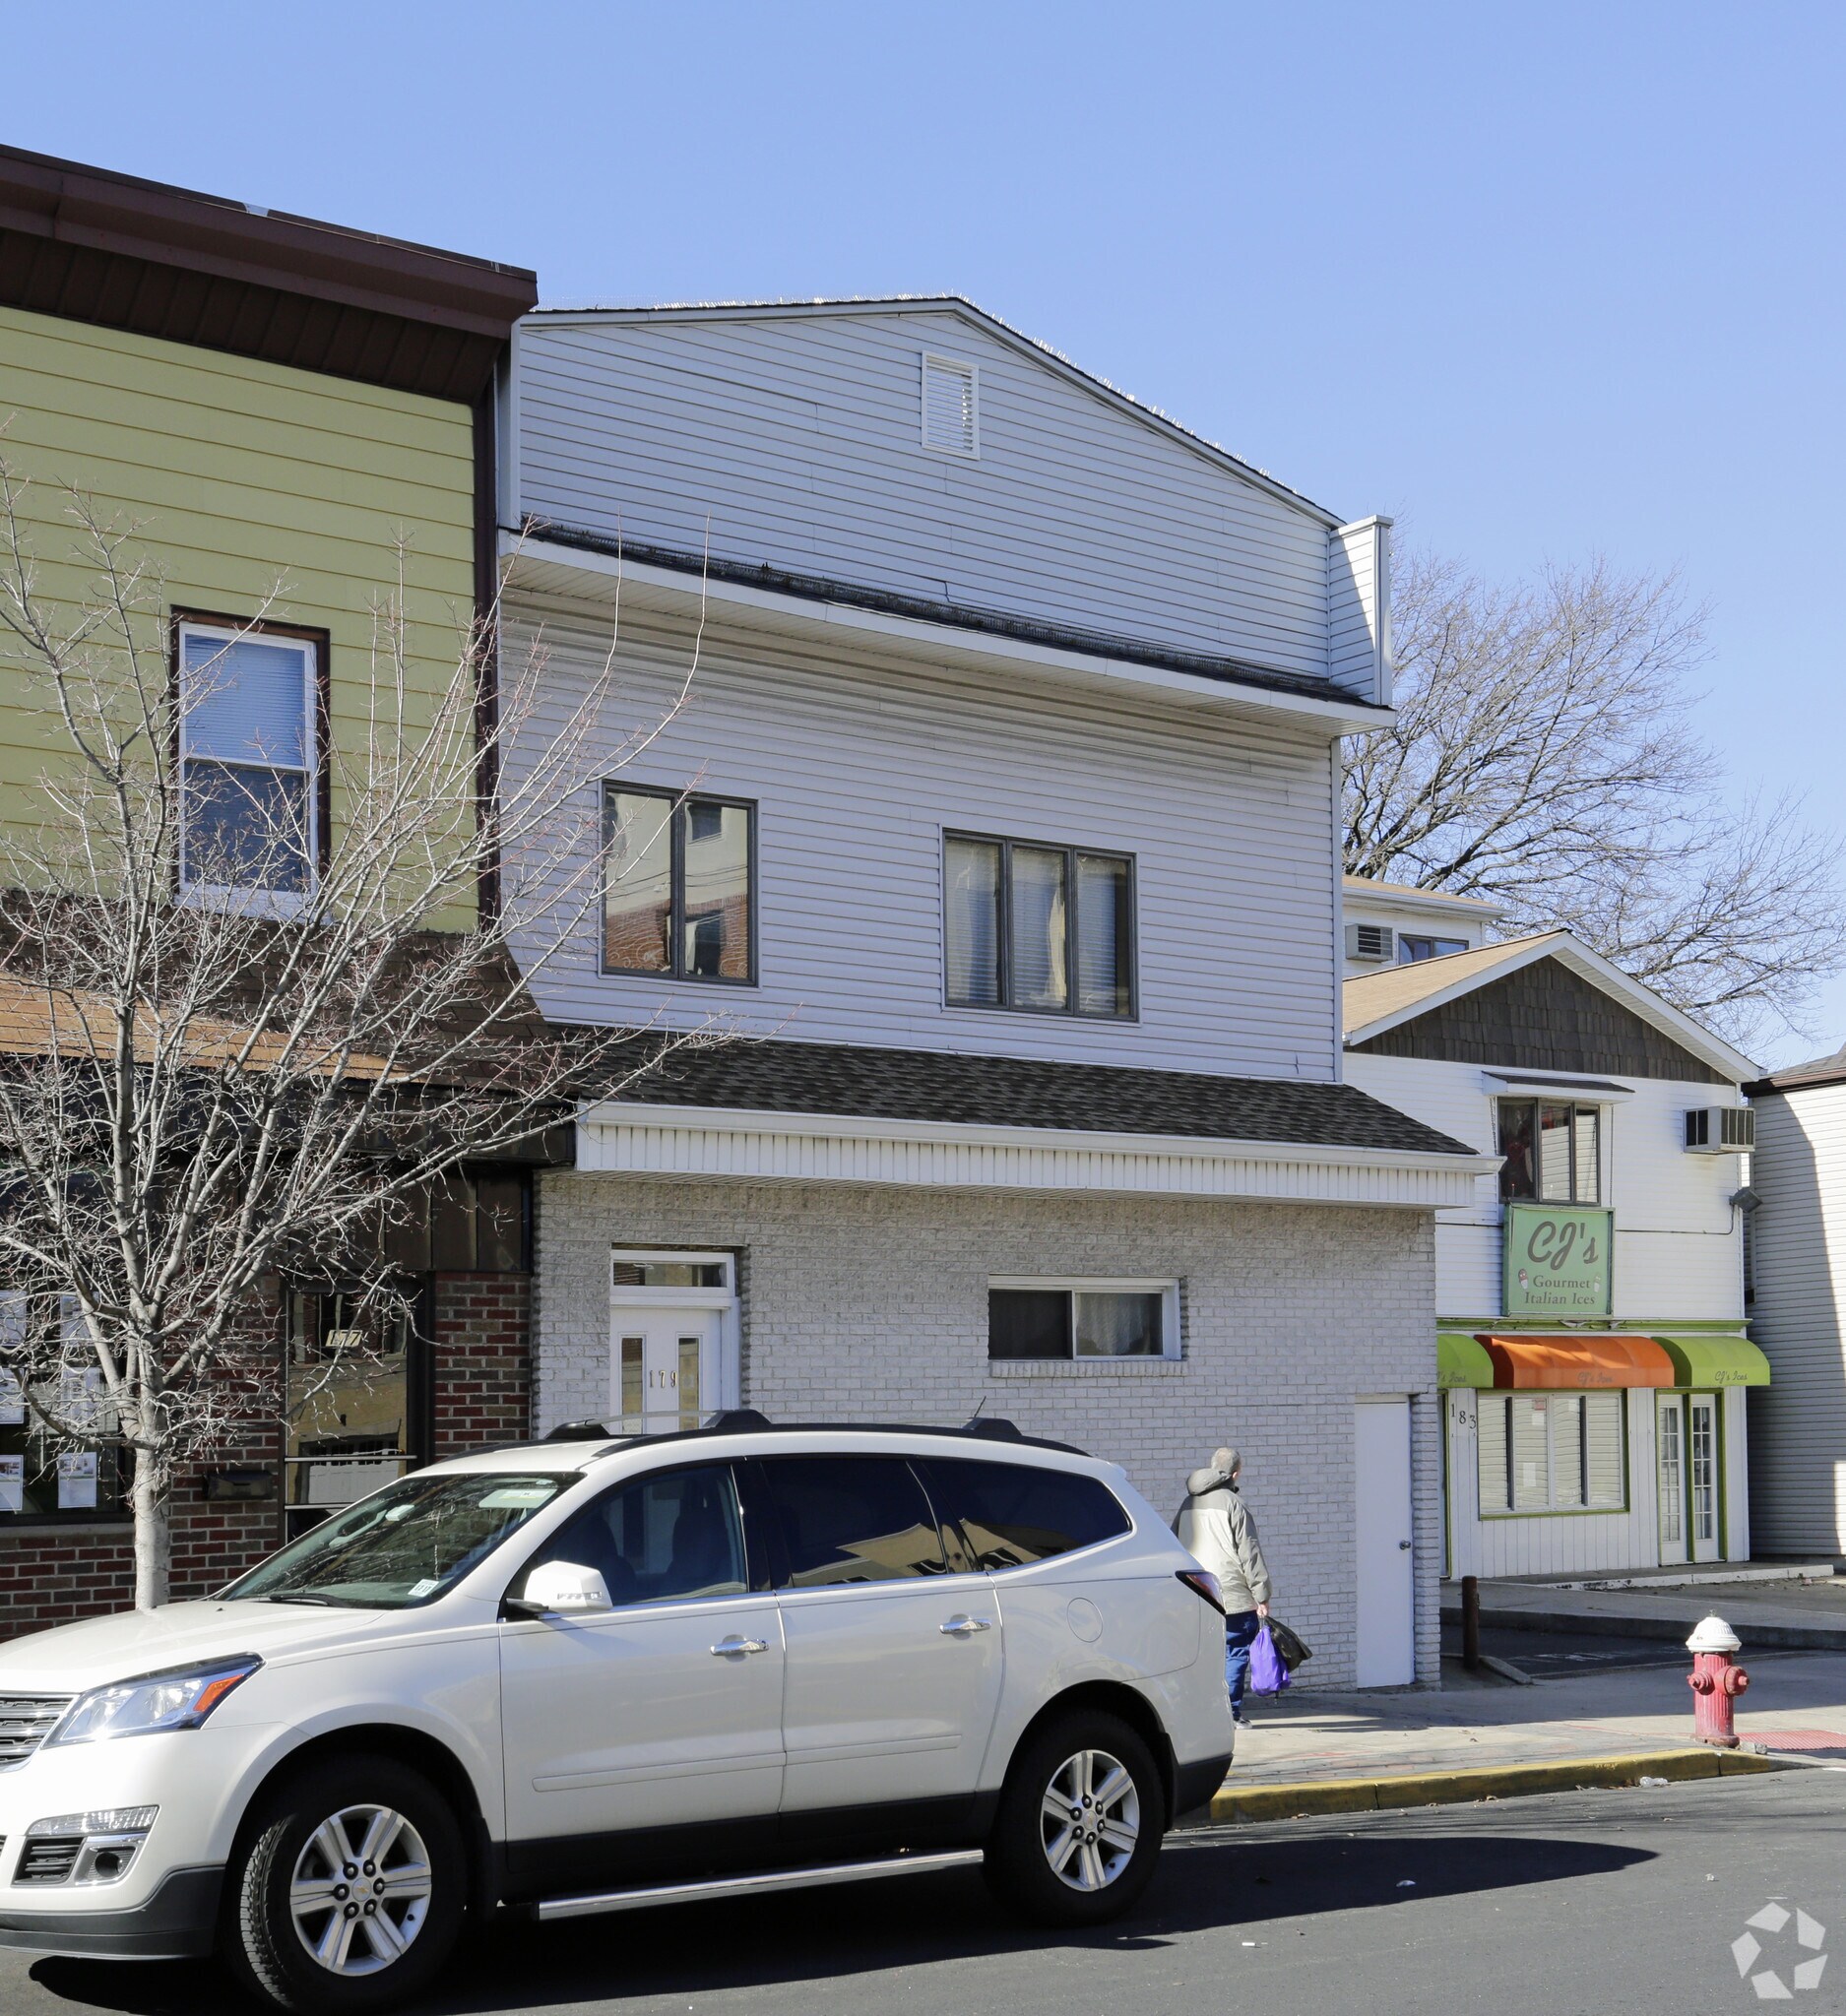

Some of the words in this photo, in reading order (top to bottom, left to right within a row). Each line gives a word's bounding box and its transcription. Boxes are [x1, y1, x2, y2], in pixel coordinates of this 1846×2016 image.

[1527, 1221, 1599, 1271] CJ's
[1533, 1275, 1590, 1289] Gourmet
[1525, 1292, 1566, 1305] Italian
[1572, 1292, 1596, 1305] Ices
[649, 1369, 677, 1388] 179
[1714, 1370, 1730, 1384] CJ's
[1732, 1370, 1748, 1381] Ices
[1451, 1404, 1477, 1430] 183
